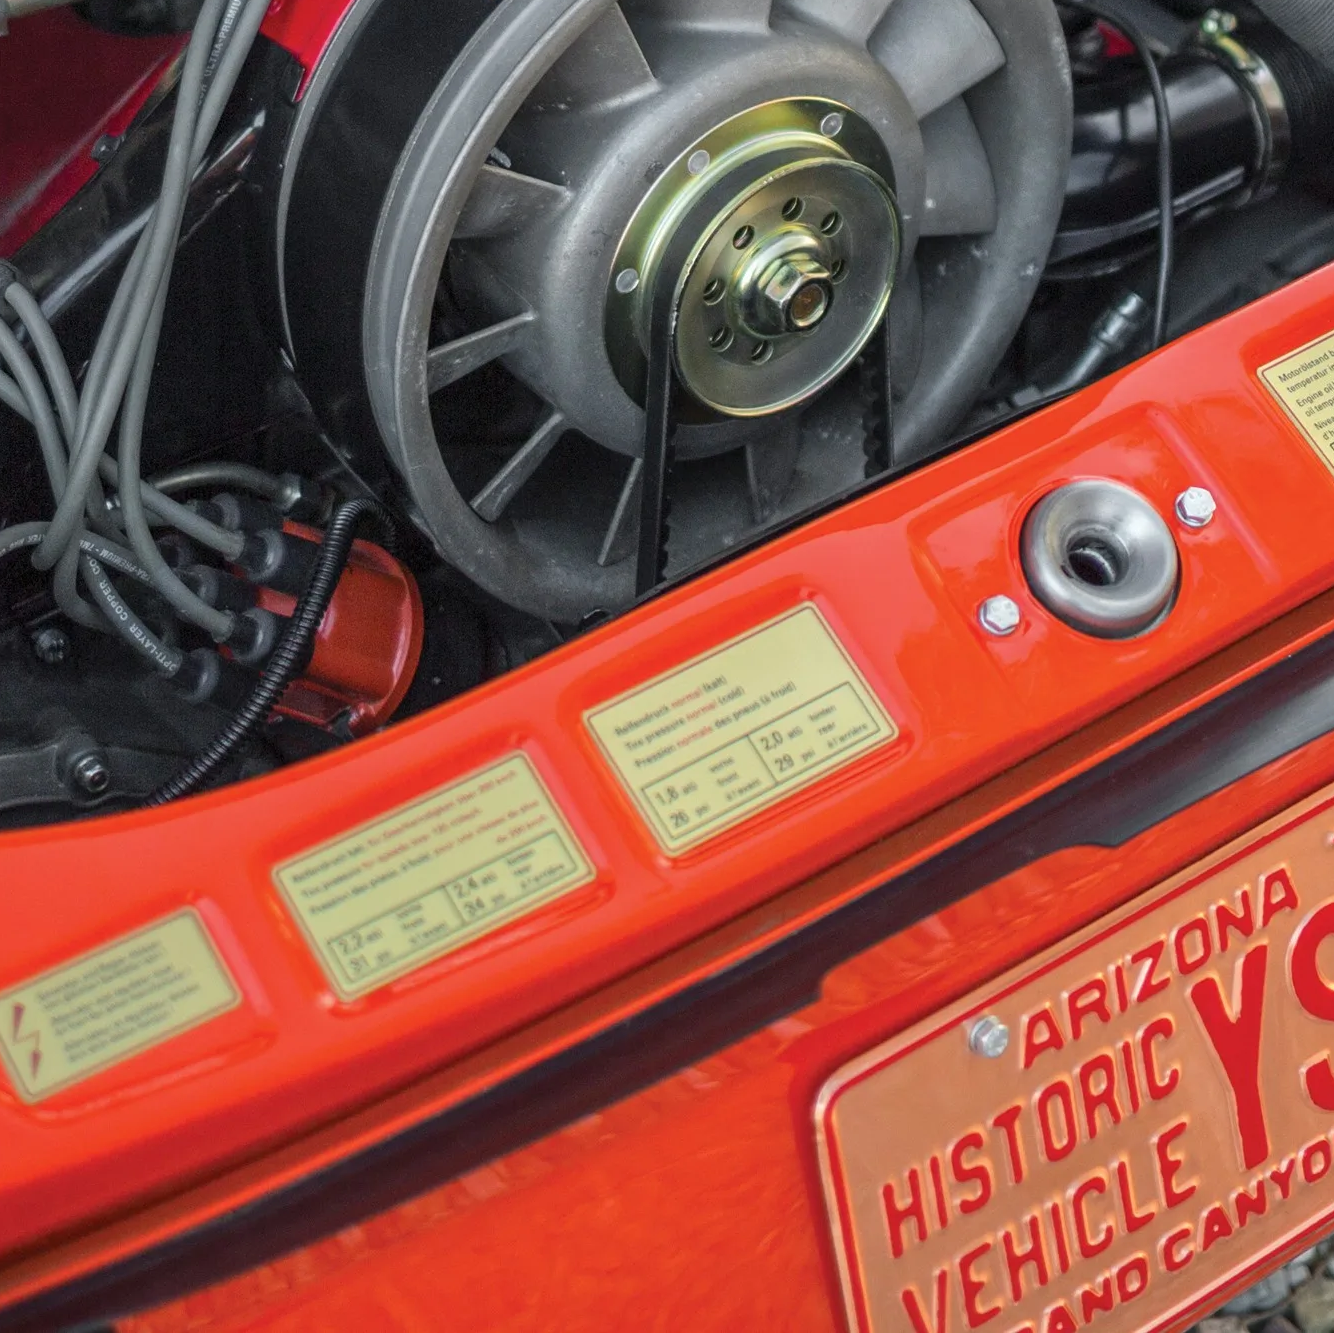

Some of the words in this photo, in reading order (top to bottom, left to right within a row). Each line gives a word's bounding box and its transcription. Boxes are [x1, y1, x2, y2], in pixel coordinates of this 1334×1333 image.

[1278, 352, 1330, 382] Motorölstand
[1286, 369, 1328, 393] temperatur
[1296, 390, 1324, 407] Engine
[1305, 407, 1316, 417] oil
[86, 554, 100, 575] CO
[99, 579, 128, 621] COPPER
[1023, 868, 1298, 1068] ARIZONA
[881, 1018, 1180, 1258] HISTORIC
[901, 1122, 1197, 1333] VEHICLE
[1013, 1257, 1149, 1333] AND
